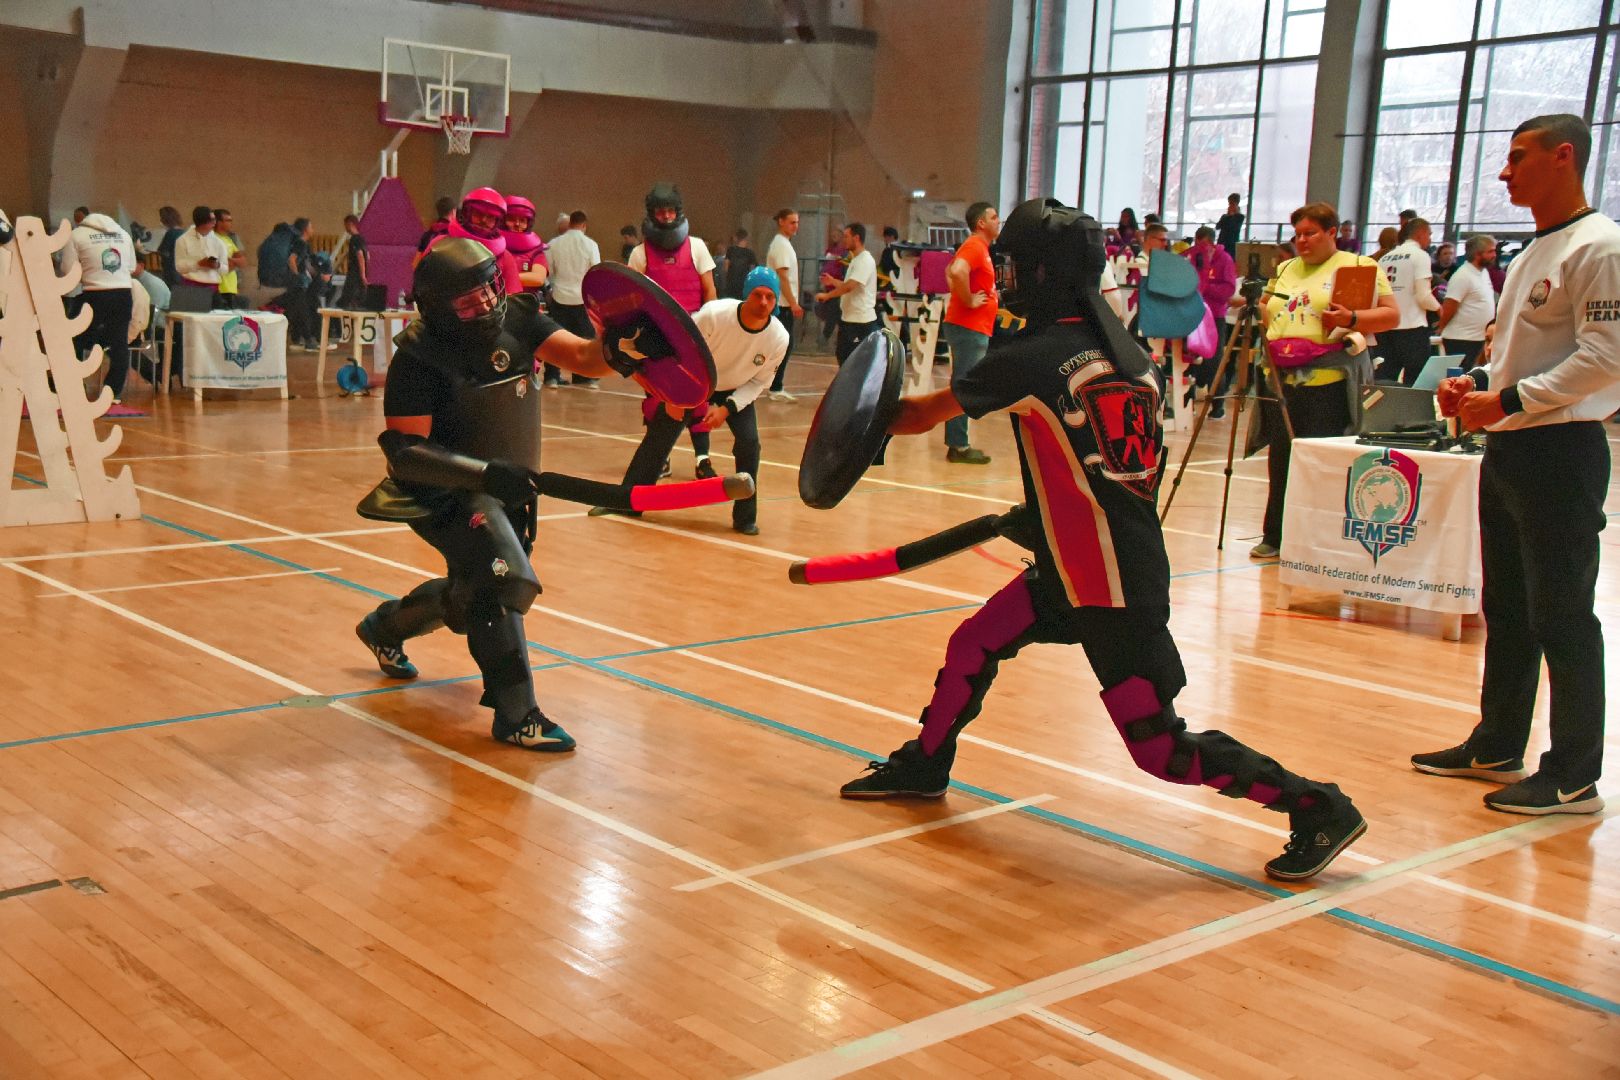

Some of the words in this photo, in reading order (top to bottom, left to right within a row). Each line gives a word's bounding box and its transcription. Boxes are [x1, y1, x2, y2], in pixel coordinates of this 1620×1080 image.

[360, 316, 376, 342] 5
[224, 351, 262, 361] IFMSF
[1342, 517, 1417, 547] IFMSF
[1322, 566, 1369, 583] Federation
[1371, 574, 1381, 584] of
[1382, 575, 1416, 589] Modern
[1417, 580, 1445, 593] Sword
